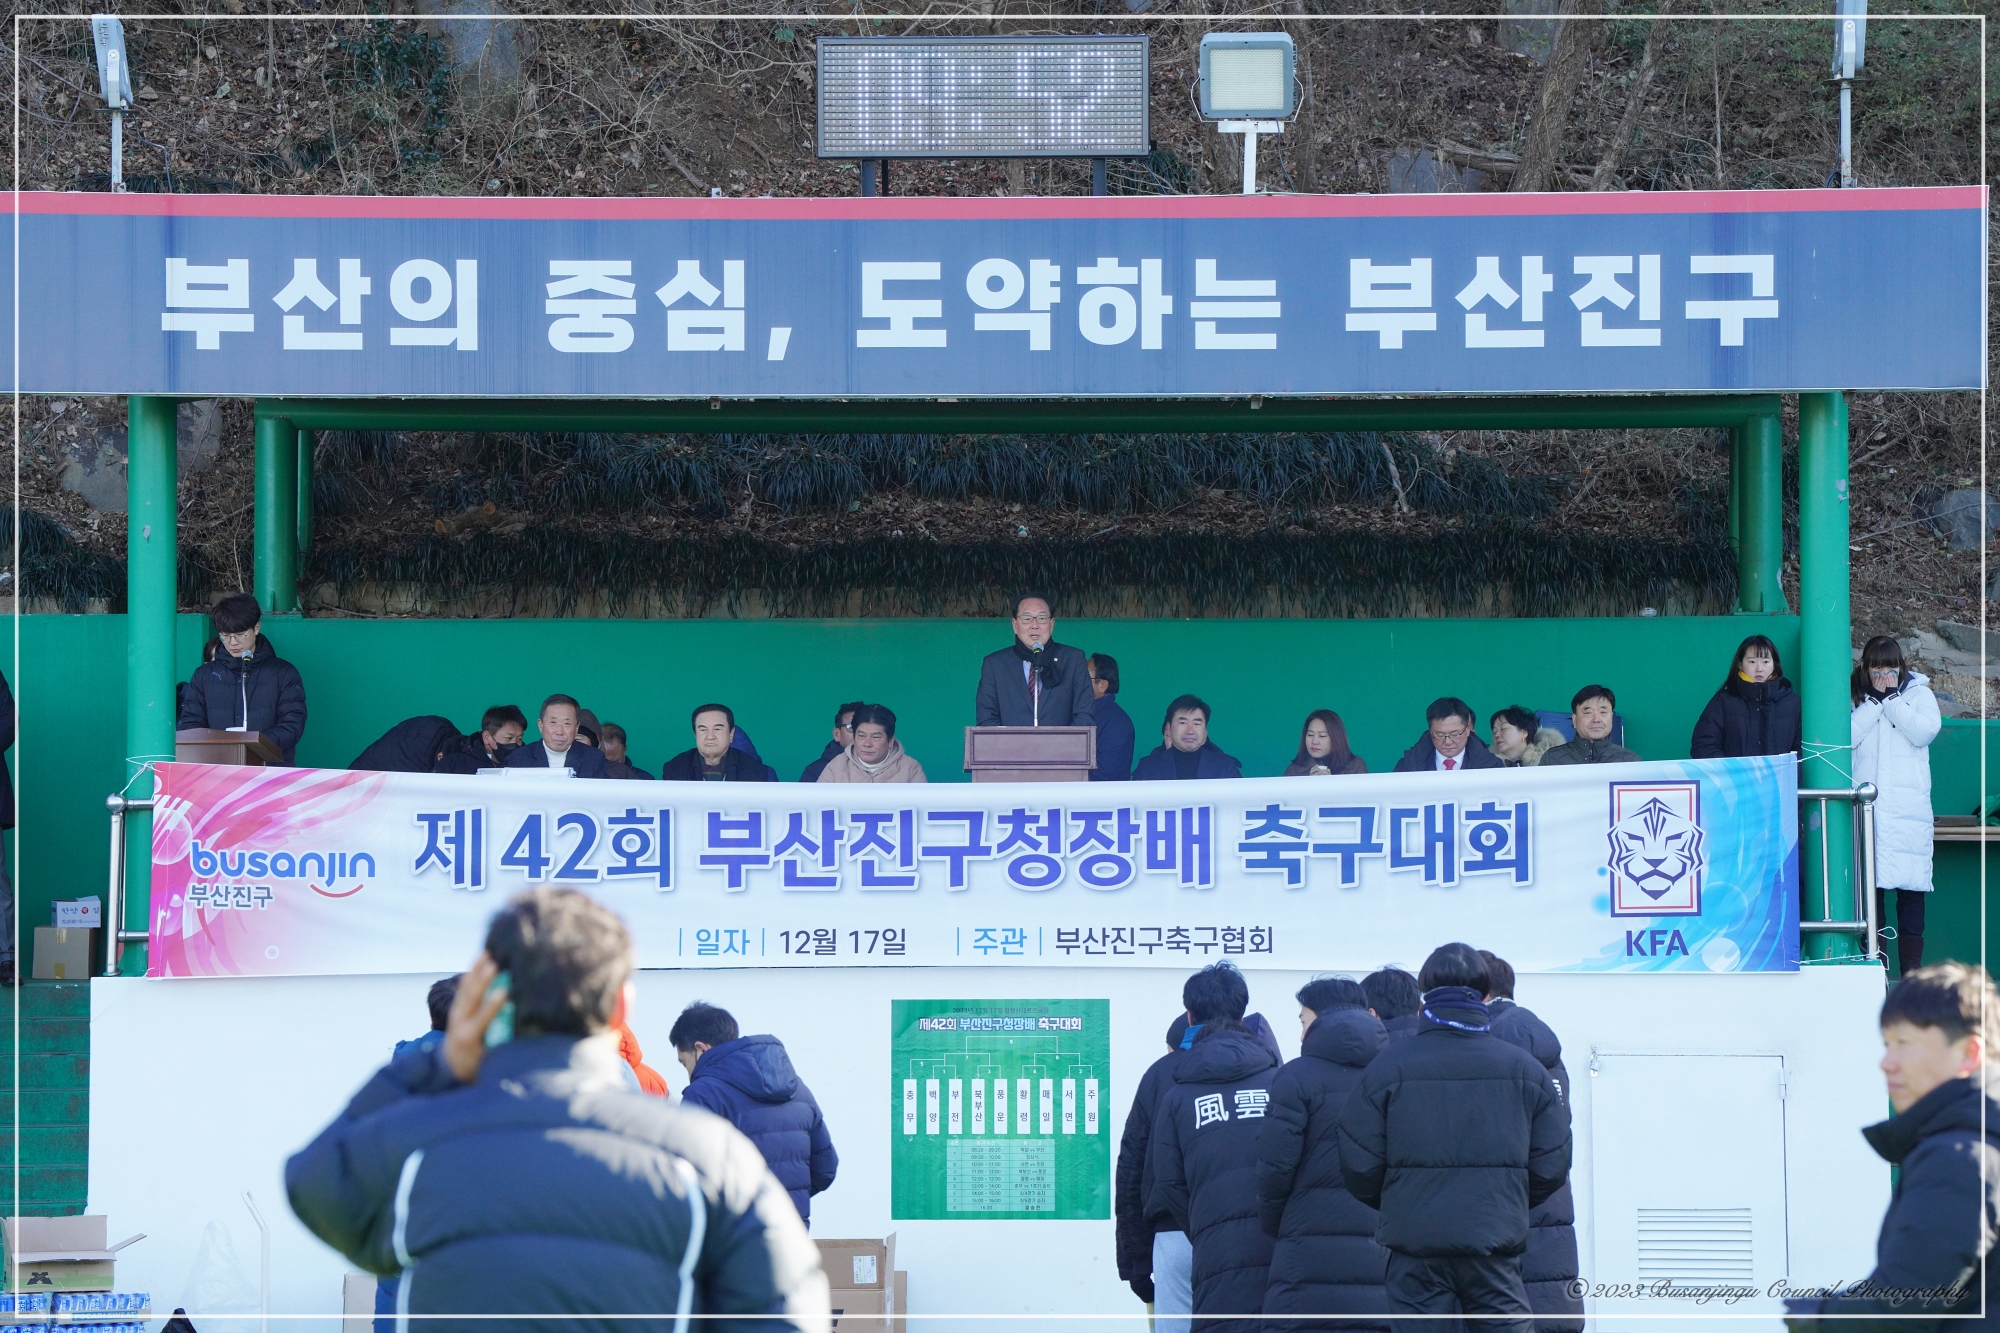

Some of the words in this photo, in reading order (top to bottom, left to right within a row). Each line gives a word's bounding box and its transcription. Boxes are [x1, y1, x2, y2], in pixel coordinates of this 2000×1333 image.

[858, 52, 1114, 143] 09:52
[162, 258, 478, 350] 부산의
[546, 260, 792, 360] 중심,
[857, 258, 1281, 350] 도약하는
[1346, 255, 1778, 349] 부산진구
[191, 841, 376, 887] busanjin
[415, 808, 483, 887] 제
[501, 807, 671, 888] 42회
[700, 805, 1211, 889] 부산진구청장배
[1238, 801, 1529, 885] 축구대회
[188, 884, 274, 908] 부산진구
[695, 928, 751, 956] 일자
[779, 928, 837, 956] 12월
[848, 927, 906, 956] 17일
[972, 927, 1028, 956] 주관
[1055, 925, 1273, 956] 부산진구축구협회
[1625, 929, 1690, 957] KFA
[919, 1017, 957, 1031] 제42회
[959, 1017, 1036, 1031] 부산진구청장배
[1038, 1017, 1082, 1031] 축구대회
[1195, 1089, 1270, 1130] 風雲
